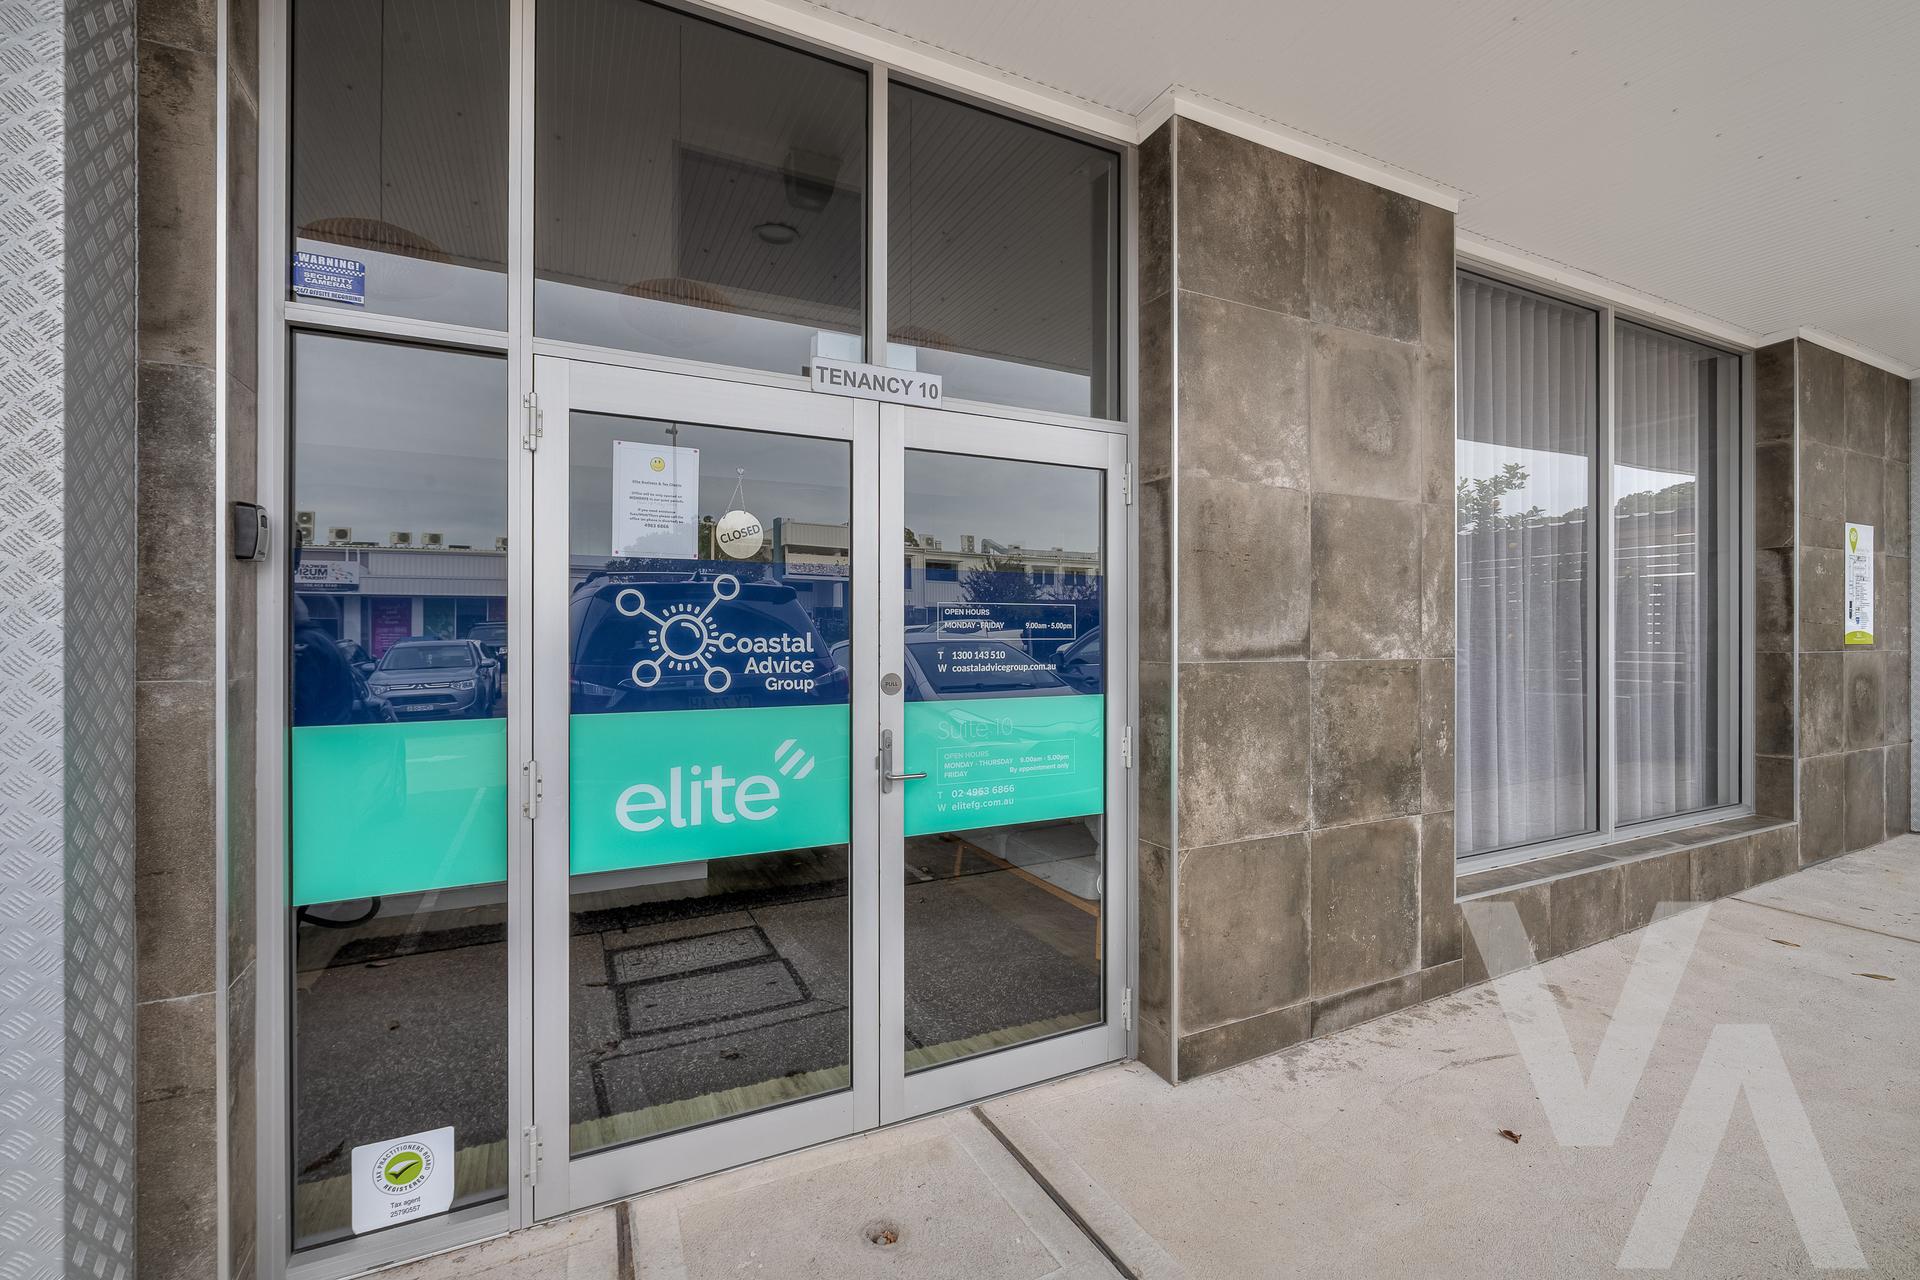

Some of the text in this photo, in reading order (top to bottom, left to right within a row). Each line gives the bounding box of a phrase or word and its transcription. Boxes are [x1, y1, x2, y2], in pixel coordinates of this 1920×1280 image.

[298, 253, 360, 271] WARNING!
[304, 271, 353, 284] SECURITY
[304, 277, 352, 290] CAMERAS
[296, 287, 309, 295] 24/7
[309, 289, 331, 298] OFFSITE
[331, 292, 362, 302] RECORDING
[816, 366, 939, 400] TENANCY 10
[720, 524, 761, 544] CLOSED
[944, 608, 990, 616] OPEN HOURS
[1025, 622, 1046, 630] 9.00am
[1051, 622, 1073, 631] 5.00pm
[718, 632, 814, 653] Coastal
[938, 651, 1006, 660] T 1300 143 510
[744, 657, 814, 674] Advice
[938, 663, 1057, 673] W coastaladvicegroup.com.au
[765, 678, 814, 692] Group
[937, 717, 1013, 740] Suite 10
[944, 751, 989, 760] OPEN HOURS
[944, 761, 974, 769] MONDAY
[979, 758, 1013, 767] THURSDAY
[944, 771, 968, 779] FRIDAY
[1010, 766, 1017, 774] By
[1019, 763, 1056, 773] appointment
[615, 765, 780, 832] elite
[937, 791, 943, 799] T
[952, 788, 964, 799] 02
[938, 798, 1015, 812] W elitefg.com.au
[378, 1145, 424, 1169] PRACTITIONERS
[423, 1151, 431, 1171] BOARD
[383, 1175, 425, 1192] REGISTERED
[403, 1196, 421, 1206] agent
[390, 1205, 421, 1218] 25790557
